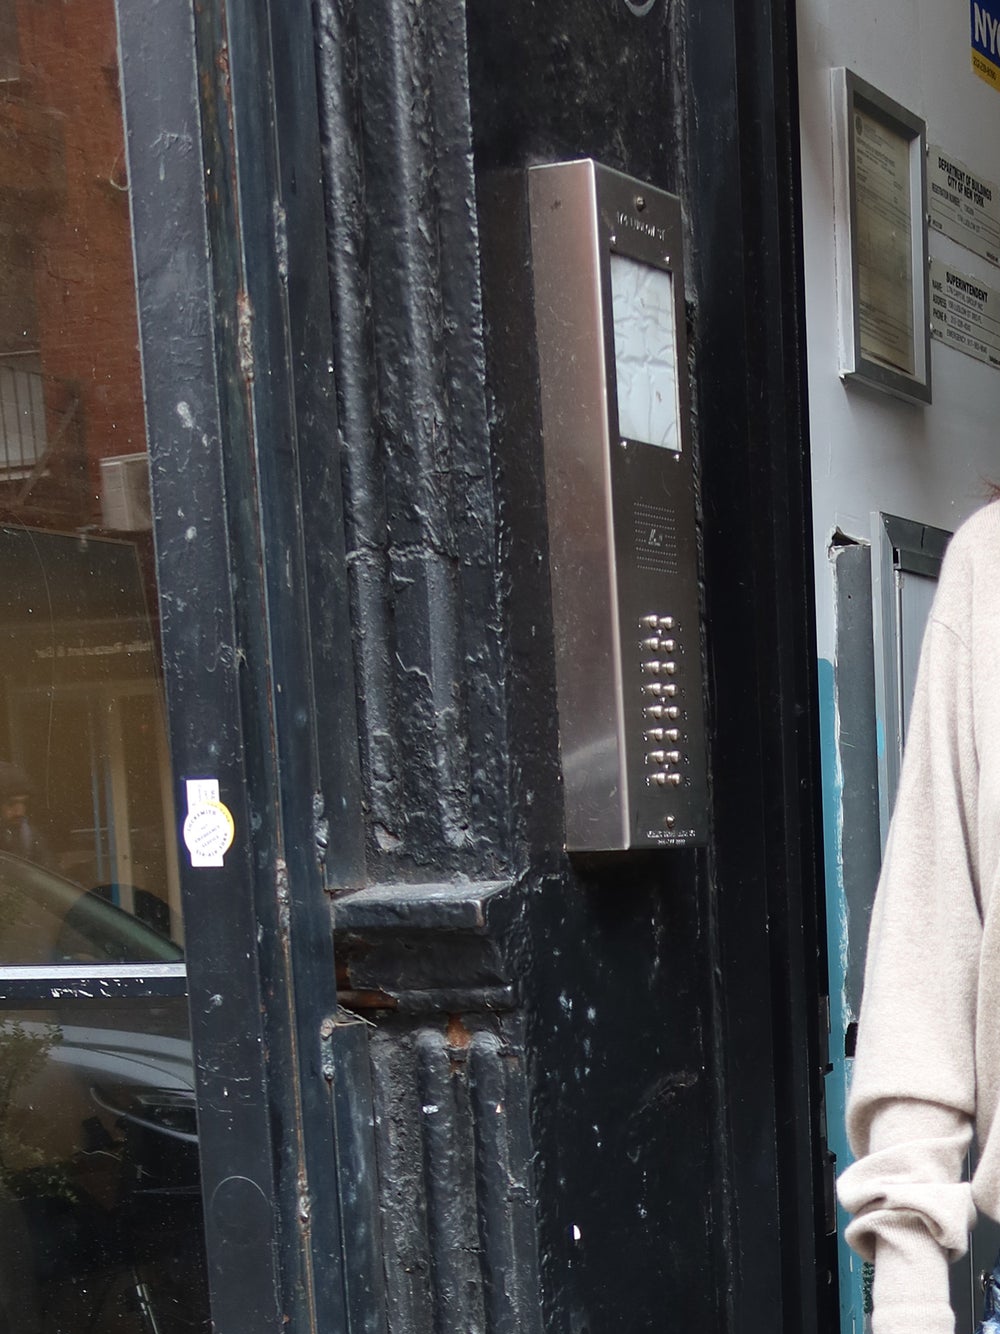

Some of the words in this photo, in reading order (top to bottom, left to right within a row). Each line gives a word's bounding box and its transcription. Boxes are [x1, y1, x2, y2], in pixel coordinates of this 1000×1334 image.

[938, 156, 965, 182] DEPARTMENT
[966, 174, 971, 187] OF
[971, 178, 992, 202] BUILDINGS
[947, 175, 957, 192] CITY
[957, 182, 963, 194] OF
[963, 186, 973, 201] NEW
[973, 191, 984, 208] YORK
[946, 271, 988, 303] SUPERINTENDENT
